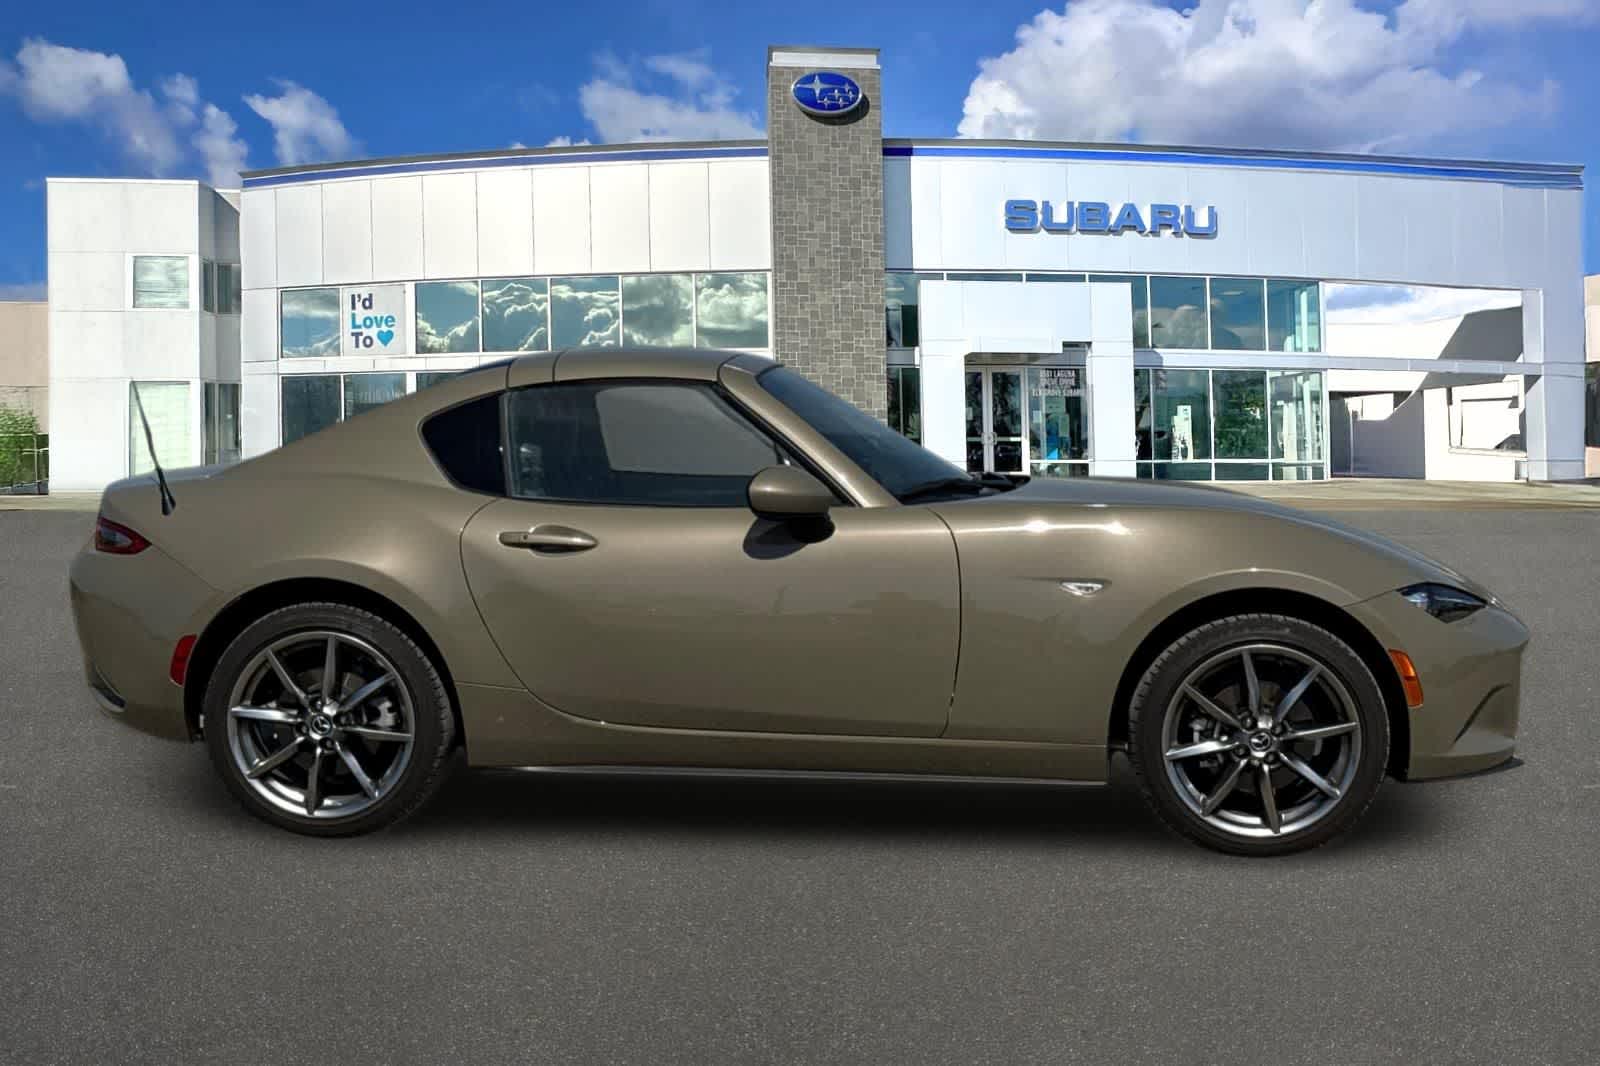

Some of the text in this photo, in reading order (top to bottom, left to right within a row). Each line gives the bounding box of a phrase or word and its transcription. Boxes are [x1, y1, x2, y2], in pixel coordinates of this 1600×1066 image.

[1005, 199, 1217, 237] SUBARU
[351, 293, 373, 310] I'd
[351, 312, 396, 329] Love
[351, 331, 374, 348] To
